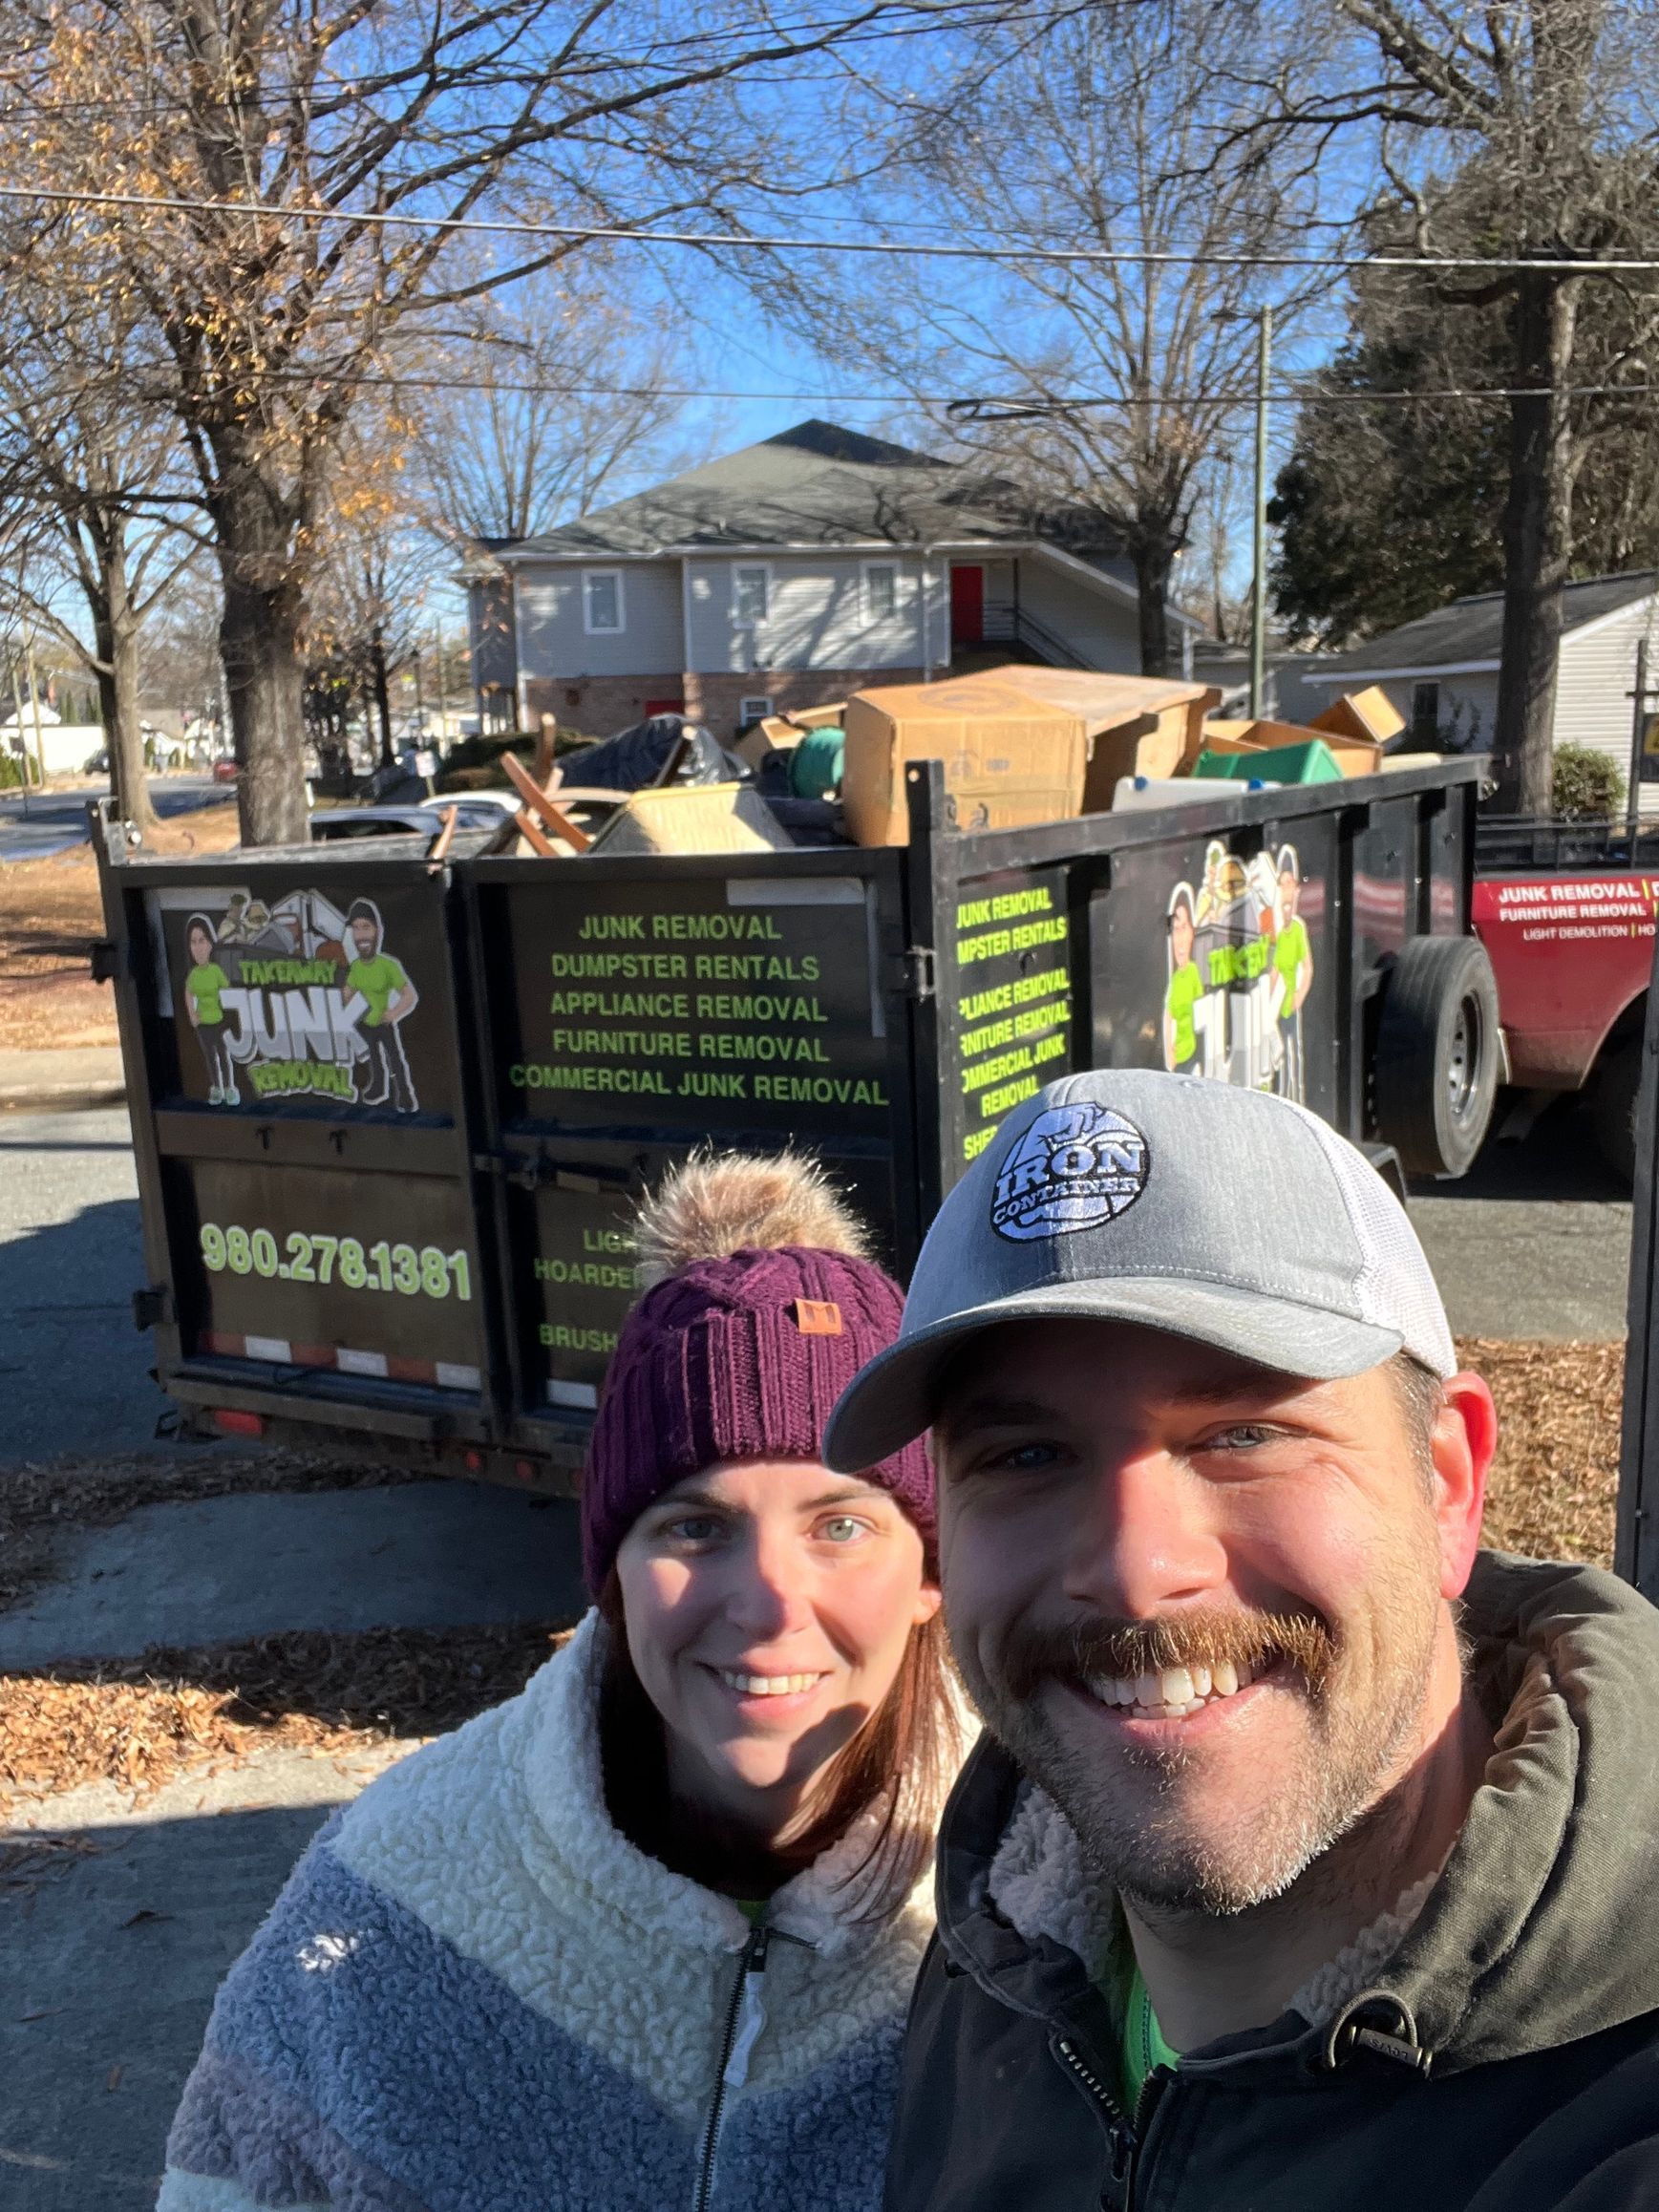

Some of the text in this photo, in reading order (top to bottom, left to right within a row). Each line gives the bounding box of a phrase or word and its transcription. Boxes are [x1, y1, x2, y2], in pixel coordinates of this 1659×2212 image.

[957, 887, 1053, 929] JUNK REMOVAL
[1499, 886, 1547, 903] JUNK
[1551, 883, 1641, 900] REMOVAL
[579, 915, 782, 941] JUNK REMOVAL
[1499, 903, 1647, 921] FURNITURE REMOVAL
[1012, 915, 1068, 950] RENTALS
[1522, 926, 1555, 940] LIGHT
[1559, 925, 1627, 940] DEMOLITION
[241, 959, 337, 986] TAKEAWAY
[552, 953, 819, 982] DUMPSTER RENTALS
[1013, 968, 1072, 1005] REMOVAL
[220, 986, 370, 1064] JUNK
[550, 993, 828, 1022] APPLIANCE REMOVAL
[1014, 1000, 1072, 1037] REMOVAL
[553, 1030, 831, 1062] FURNITURE REMOVAL
[1034, 1033, 1066, 1065] JUNK
[250, 1062, 356, 1101] REMOVAL
[510, 1065, 889, 1106] COMMERCIAL JUNK REMOVAL
[982, 1075, 1041, 1117] REMOVAL
[994, 1142, 1145, 1207] IRON
[993, 1177, 1141, 1224] CONTAINER
[201, 1223, 472, 1301] 980.278.1381
